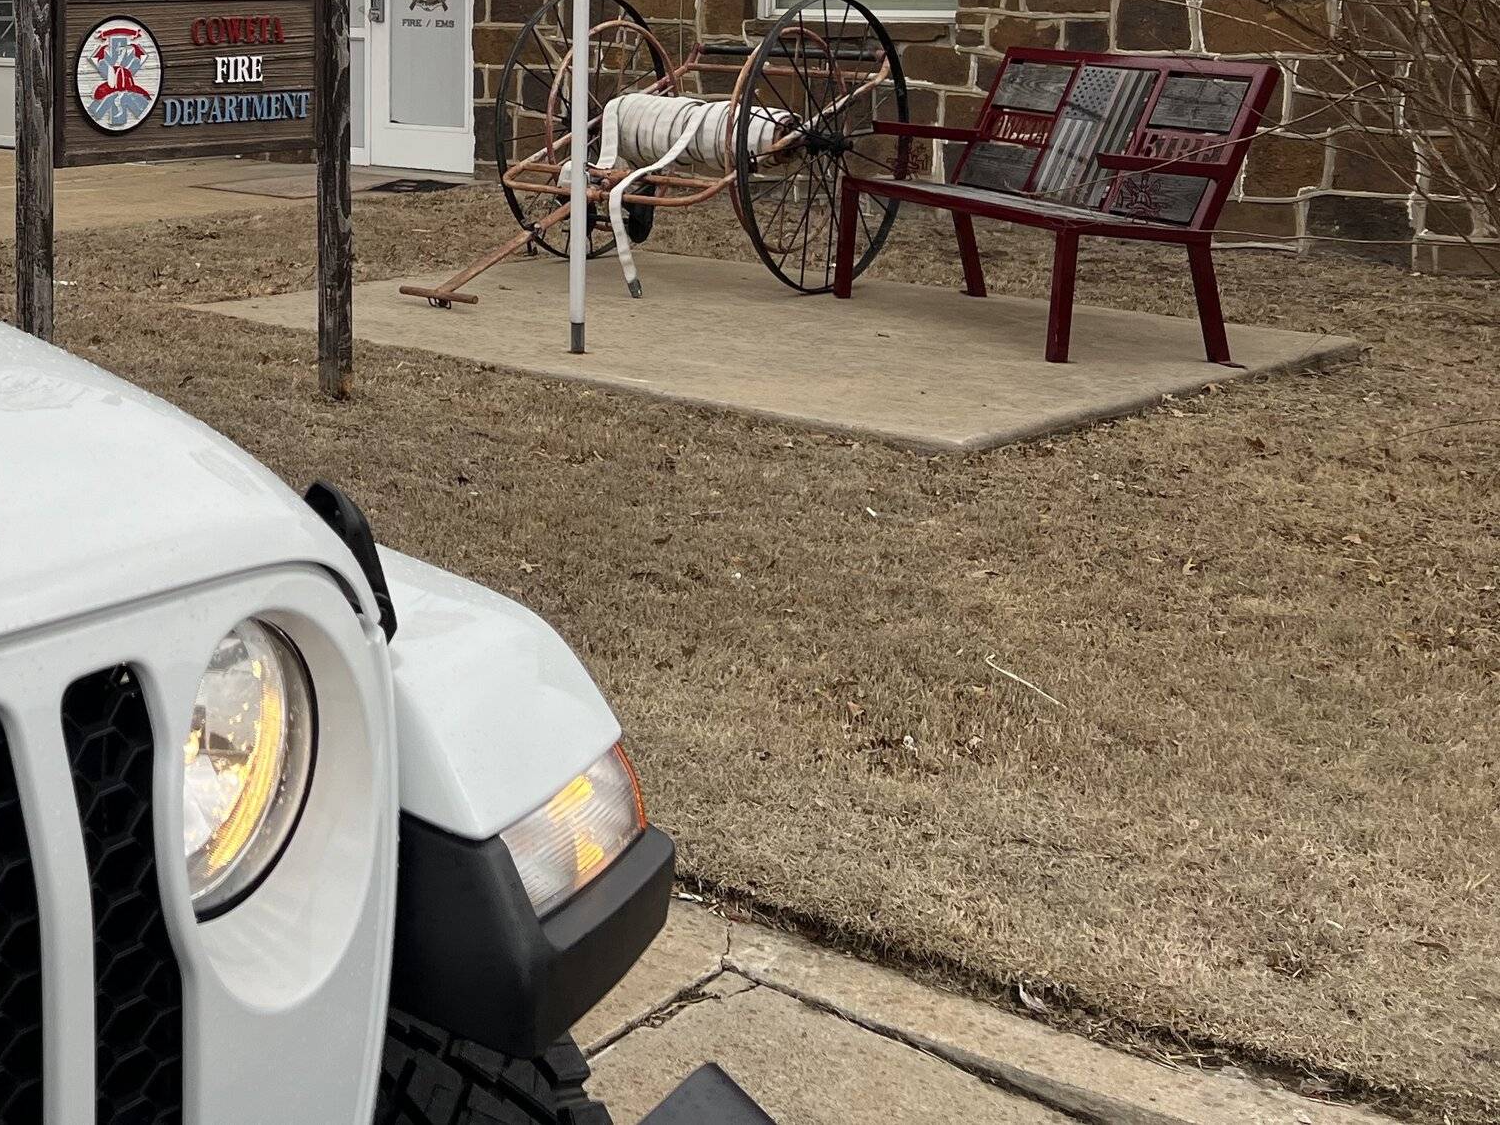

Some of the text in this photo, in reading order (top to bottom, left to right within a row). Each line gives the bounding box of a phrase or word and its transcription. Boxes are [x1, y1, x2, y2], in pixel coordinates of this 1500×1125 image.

[191, 15, 286, 45] COWETA
[401, 18, 423, 28] FIRE
[435, 19, 455, 29] EMS
[214, 55, 264, 84] FIRE
[162, 91, 311, 127] DEPARTMENT
